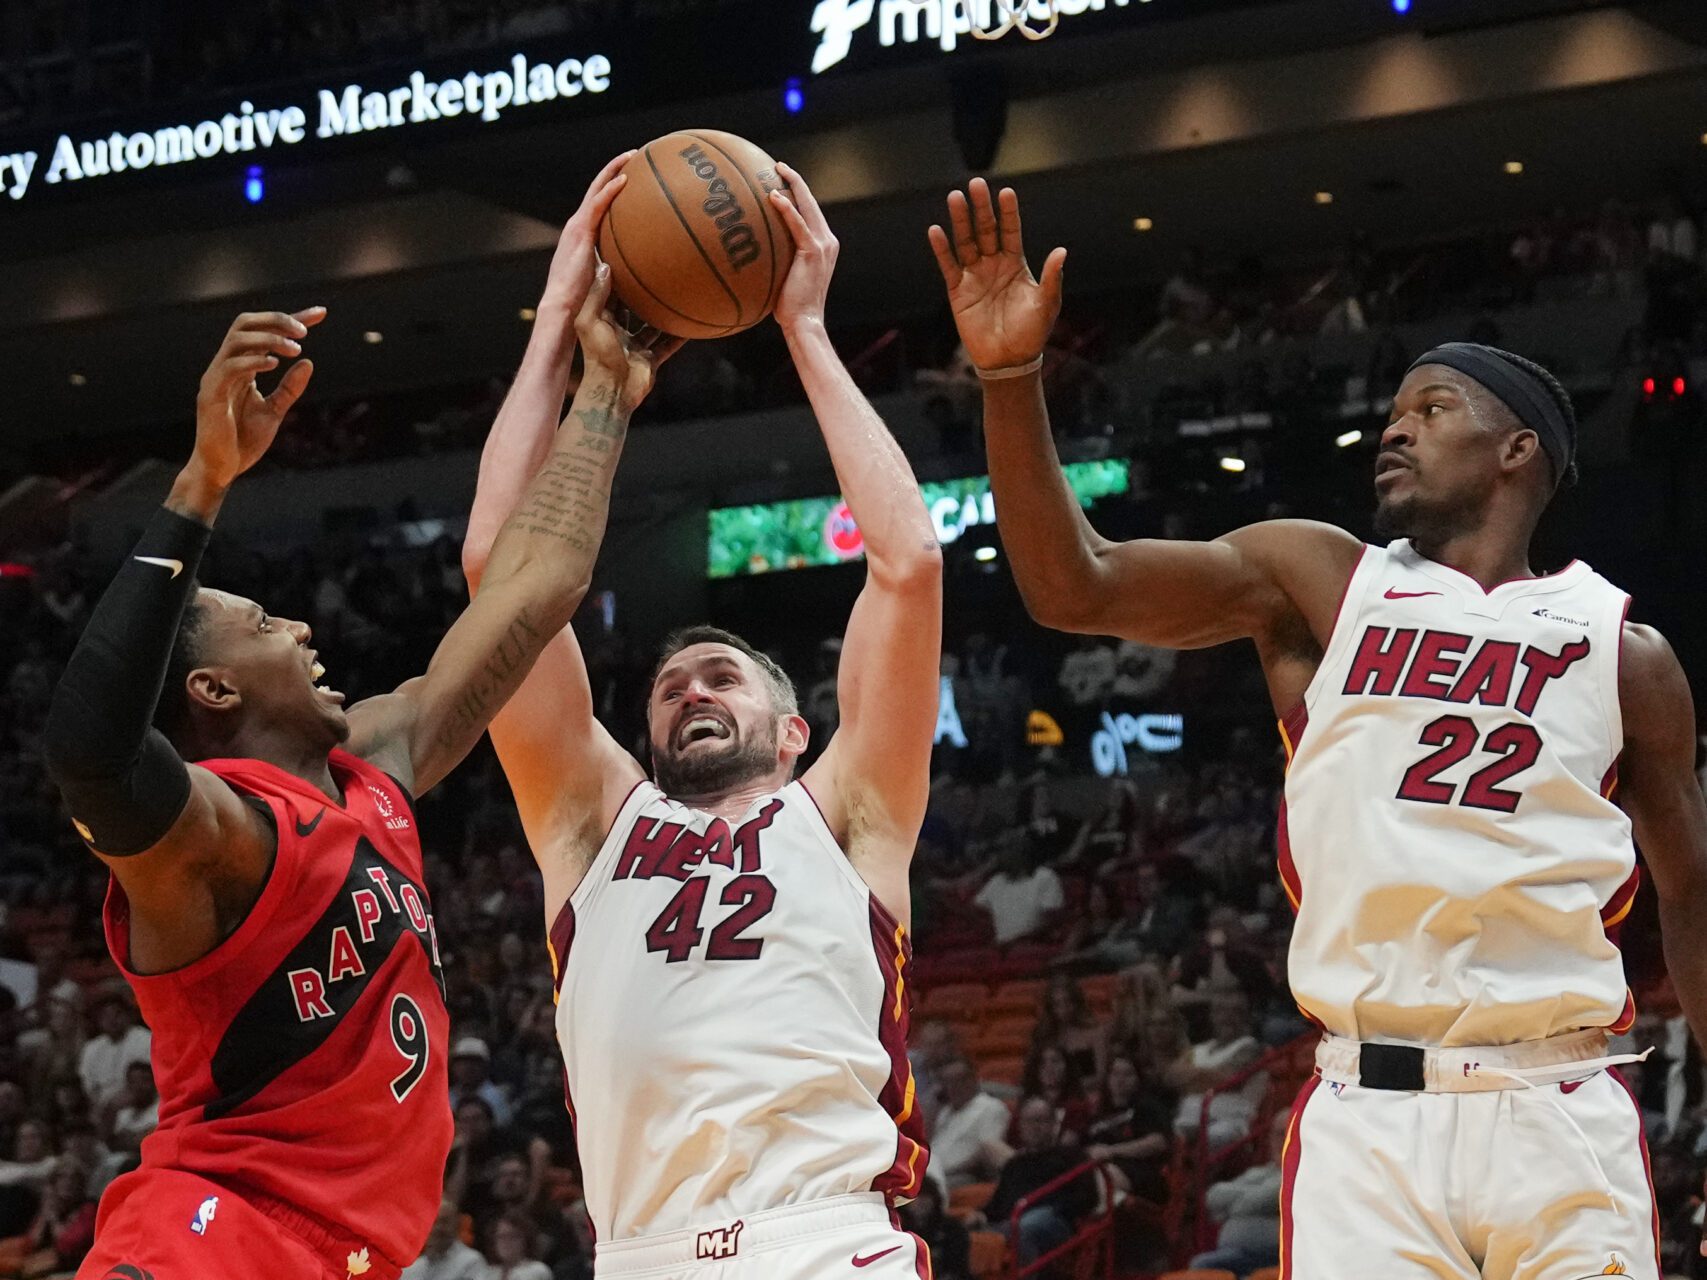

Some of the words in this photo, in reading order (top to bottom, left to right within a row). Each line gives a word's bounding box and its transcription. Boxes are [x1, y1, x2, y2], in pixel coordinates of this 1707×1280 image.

[45, 101, 305, 184] Automotive
[317, 53, 611, 138] Marketplace
[1342, 625, 1590, 717] HEAT
[1396, 715, 1543, 813] 22
[612, 798, 784, 882] HEAT
[645, 874, 777, 963] 42
[390, 993, 429, 1104] 9
